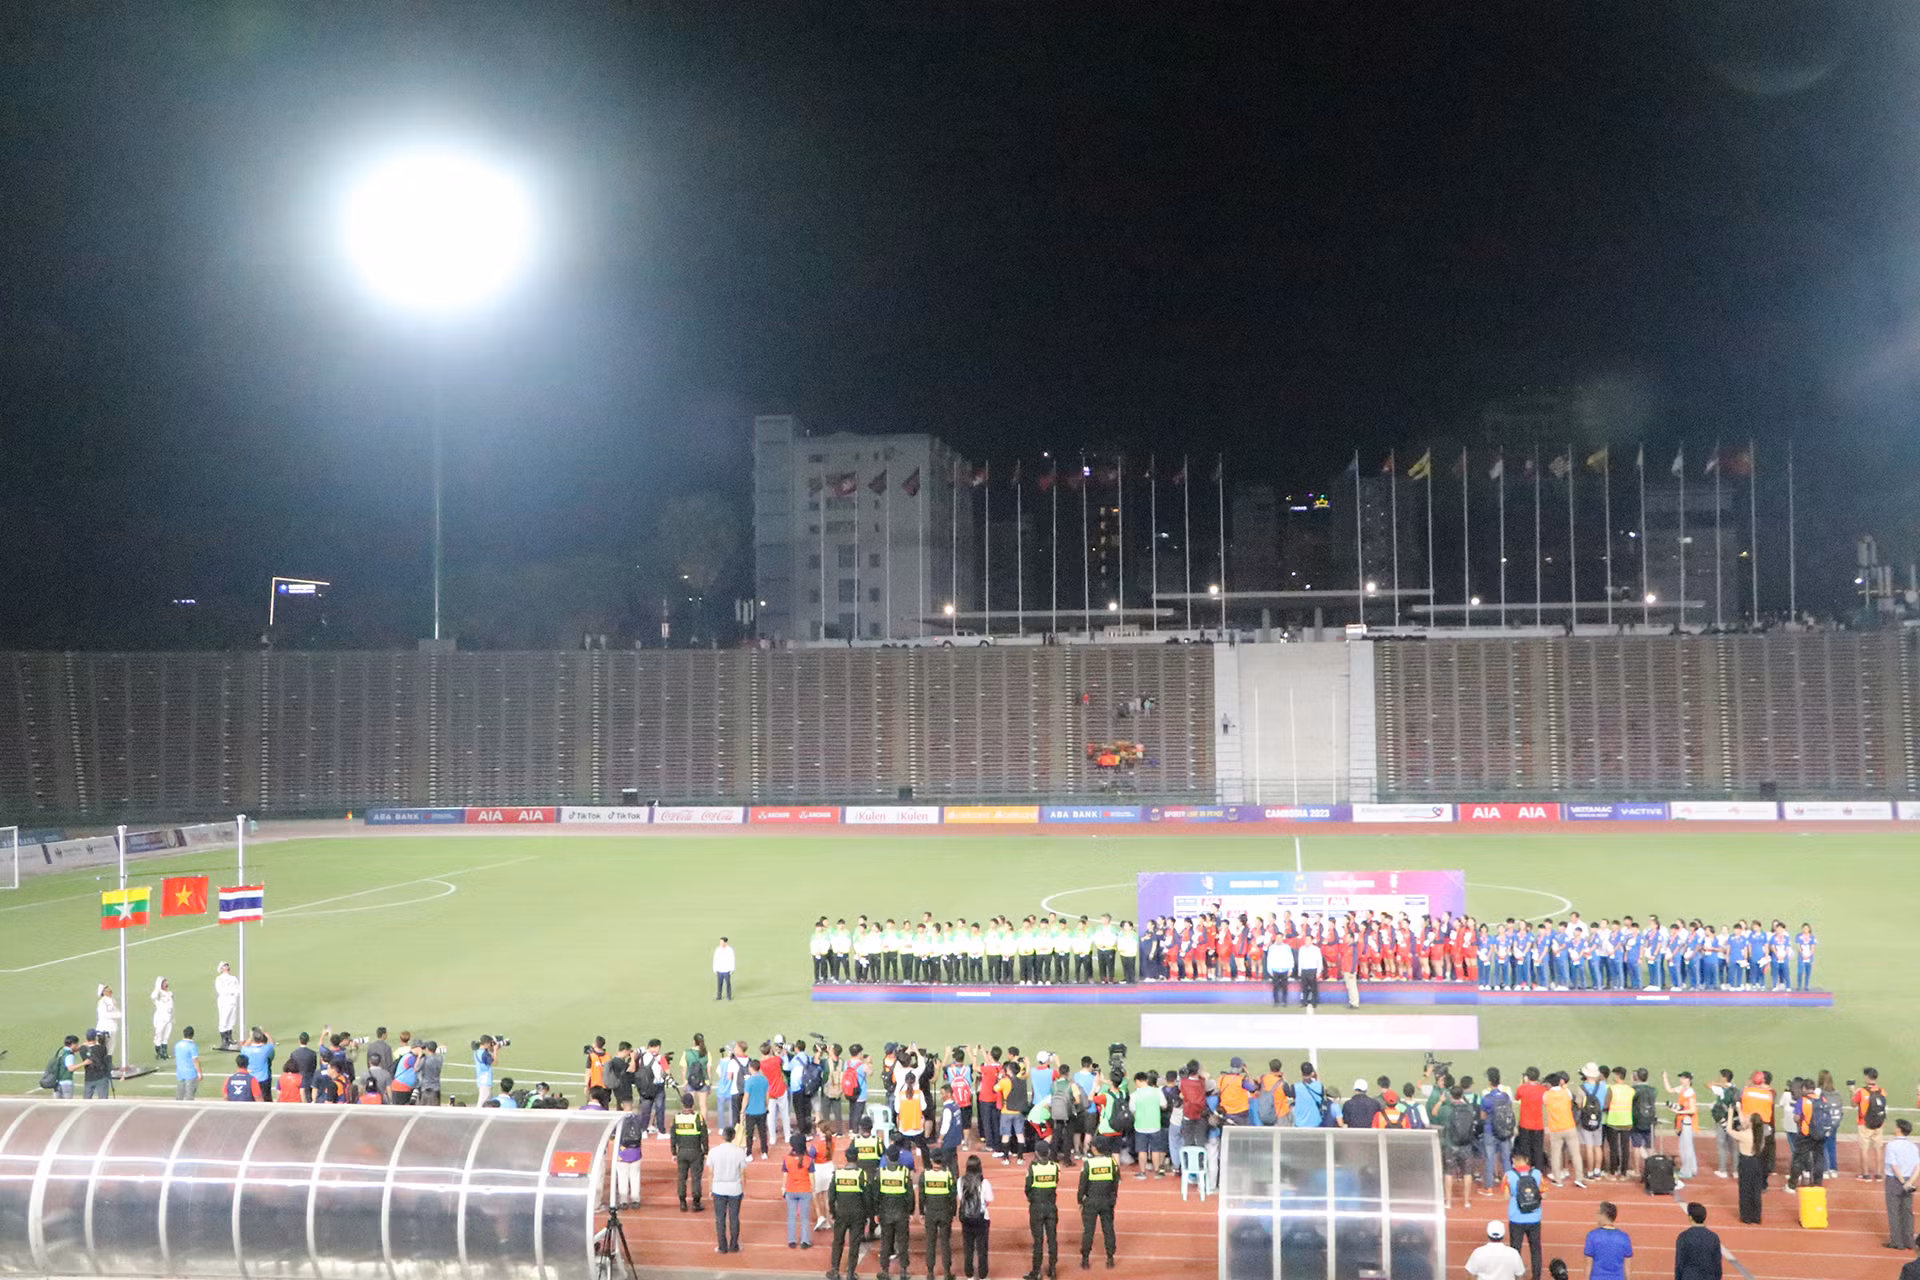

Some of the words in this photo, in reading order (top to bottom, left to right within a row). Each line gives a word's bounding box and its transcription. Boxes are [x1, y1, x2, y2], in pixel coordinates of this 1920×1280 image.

[478, 811, 503, 821] AIA
[518, 810, 544, 820] AIA
[857, 812, 886, 821] Kulen
[900, 812, 928, 821] Kulen
[1265, 809, 1308, 818] CAMBODIA
[1309, 809, 1330, 818] 2023
[1472, 807, 1500, 818] AIA
[1517, 807, 1546, 818] AIA
